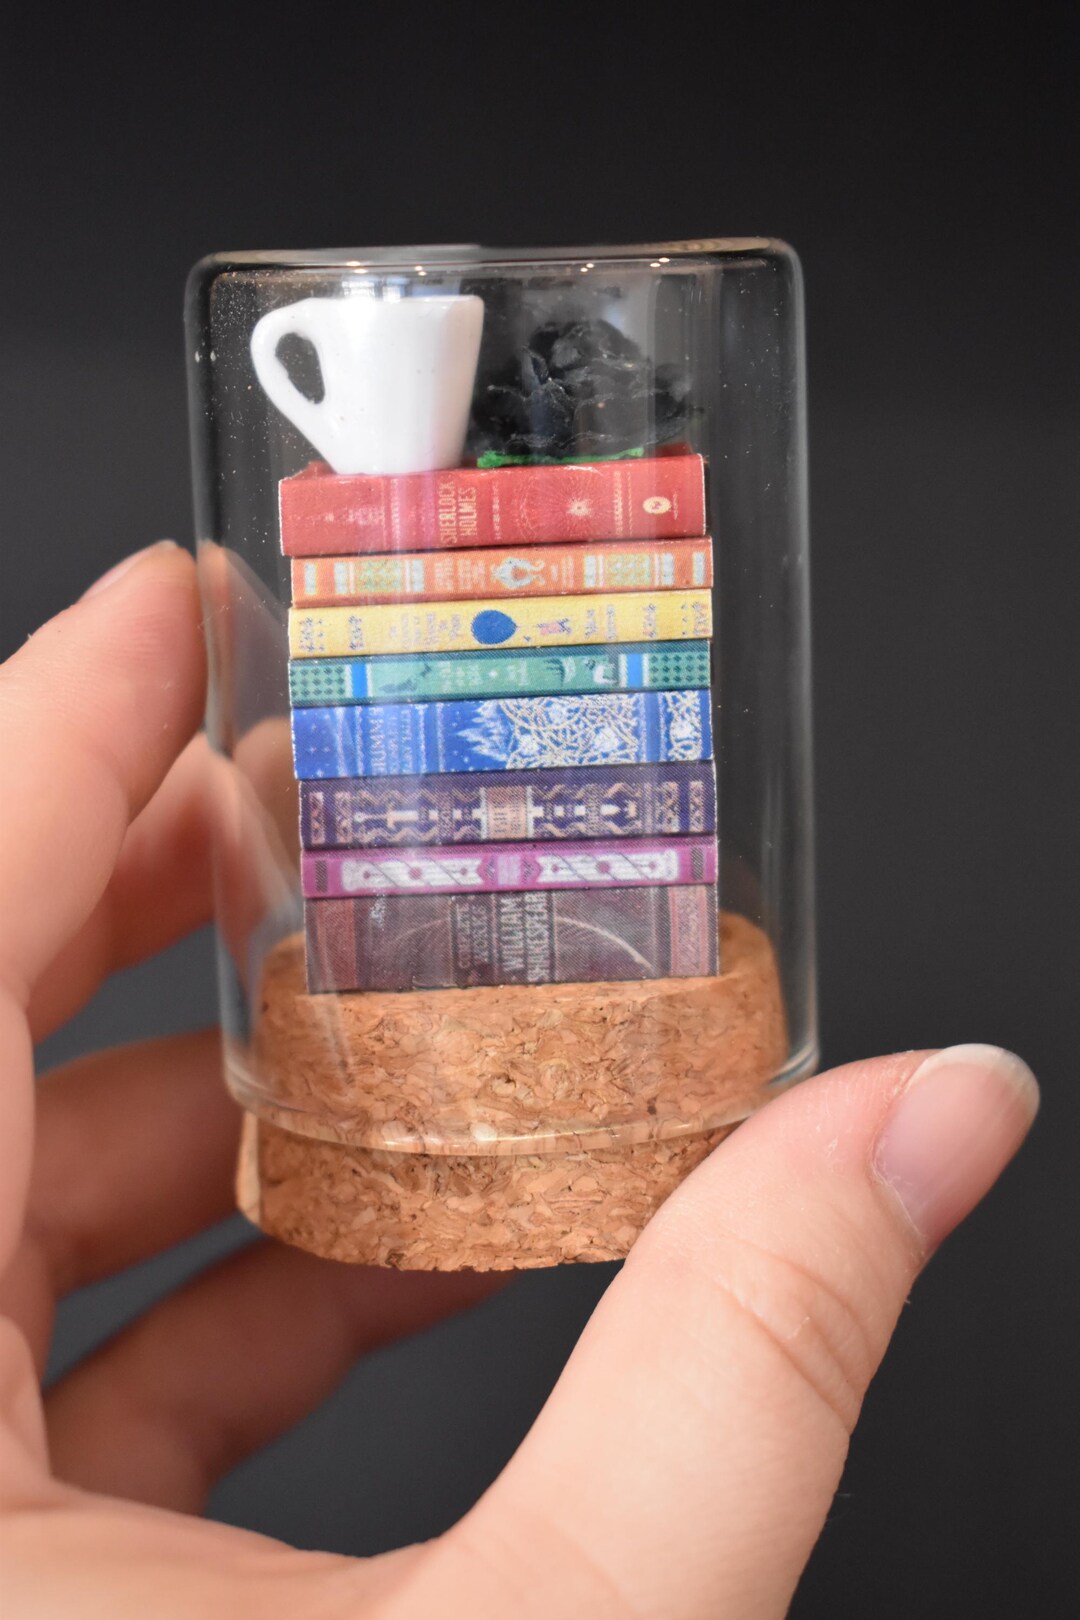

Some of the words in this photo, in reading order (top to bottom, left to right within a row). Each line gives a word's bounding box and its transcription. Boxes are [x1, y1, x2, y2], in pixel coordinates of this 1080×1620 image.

[438, 481, 457, 544] SHERLOCK
[459, 487, 478, 537] HOLMES
[500, 897, 524, 972] WILLIAM
